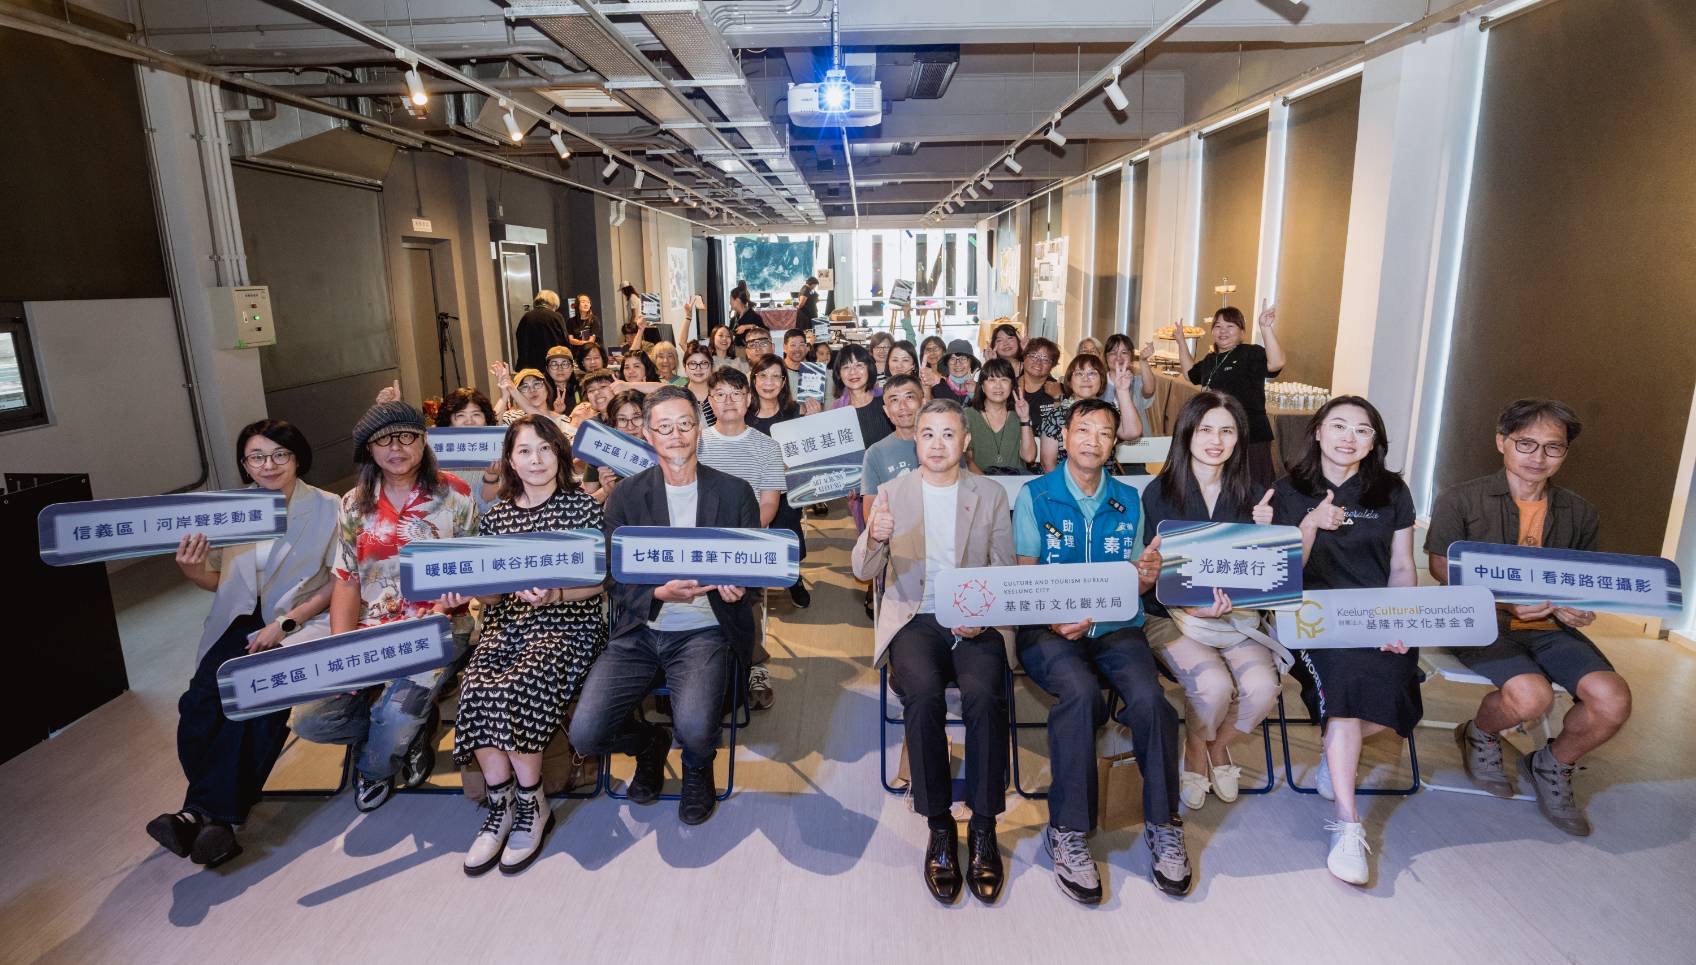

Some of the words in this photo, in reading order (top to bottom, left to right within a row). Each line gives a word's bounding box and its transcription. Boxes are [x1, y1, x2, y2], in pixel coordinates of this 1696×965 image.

[593, 440, 622, 458] 中正區
[783, 427, 855, 458] 藝渡基隆
[73, 518, 135, 542] 信義區
[156, 508, 264, 532] 河岸聲影動畫
[1062, 519, 1076, 548] 助理
[425, 560, 474, 578] 暖暖區
[492, 551, 585, 572] 峽谷拓痕共創
[632, 548, 676, 564] 七堵區
[690, 550, 778, 566] 畫筆下的山徑
[1198, 558, 1266, 577] 光跡續行
[1474, 564, 1522, 582] 中山區
[1542, 570, 1654, 593] 看海路徑攝影
[1004, 596, 1123, 612] 基隆市文化觀光局
[1366, 617, 1476, 630] 基隆市文化基金會
[250, 666, 308, 695] 仁愛區
[328, 637, 430, 674] 城市記憶檔案
